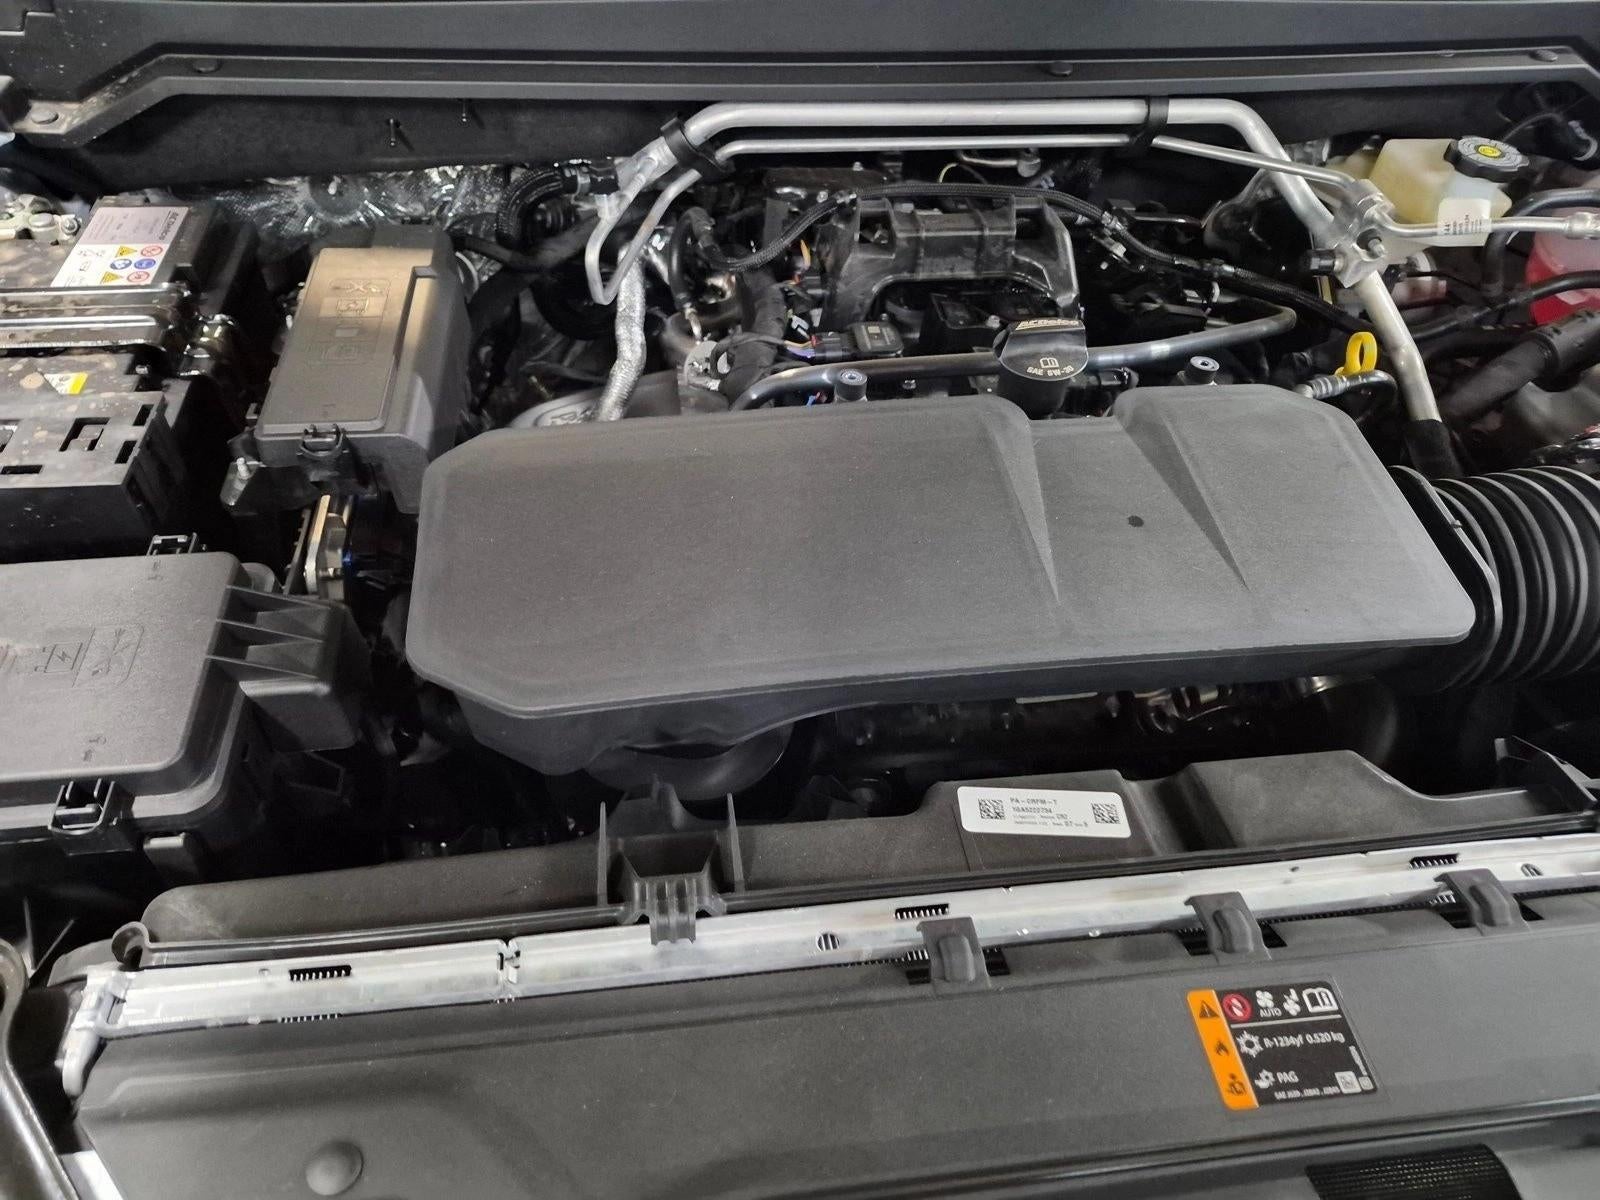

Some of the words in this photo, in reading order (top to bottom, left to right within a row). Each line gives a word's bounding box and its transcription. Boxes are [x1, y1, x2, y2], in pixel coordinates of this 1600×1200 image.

[1018, 318, 1079, 328] ACDelco
[1027, 366, 1043, 376] SAE
[1259, 1007, 1282, 1018] AUTO
[1263, 1034, 1304, 1048] R-1234yf
[1330, 1031, 1346, 1044] kg
[1276, 1070, 1299, 1084] PAG
